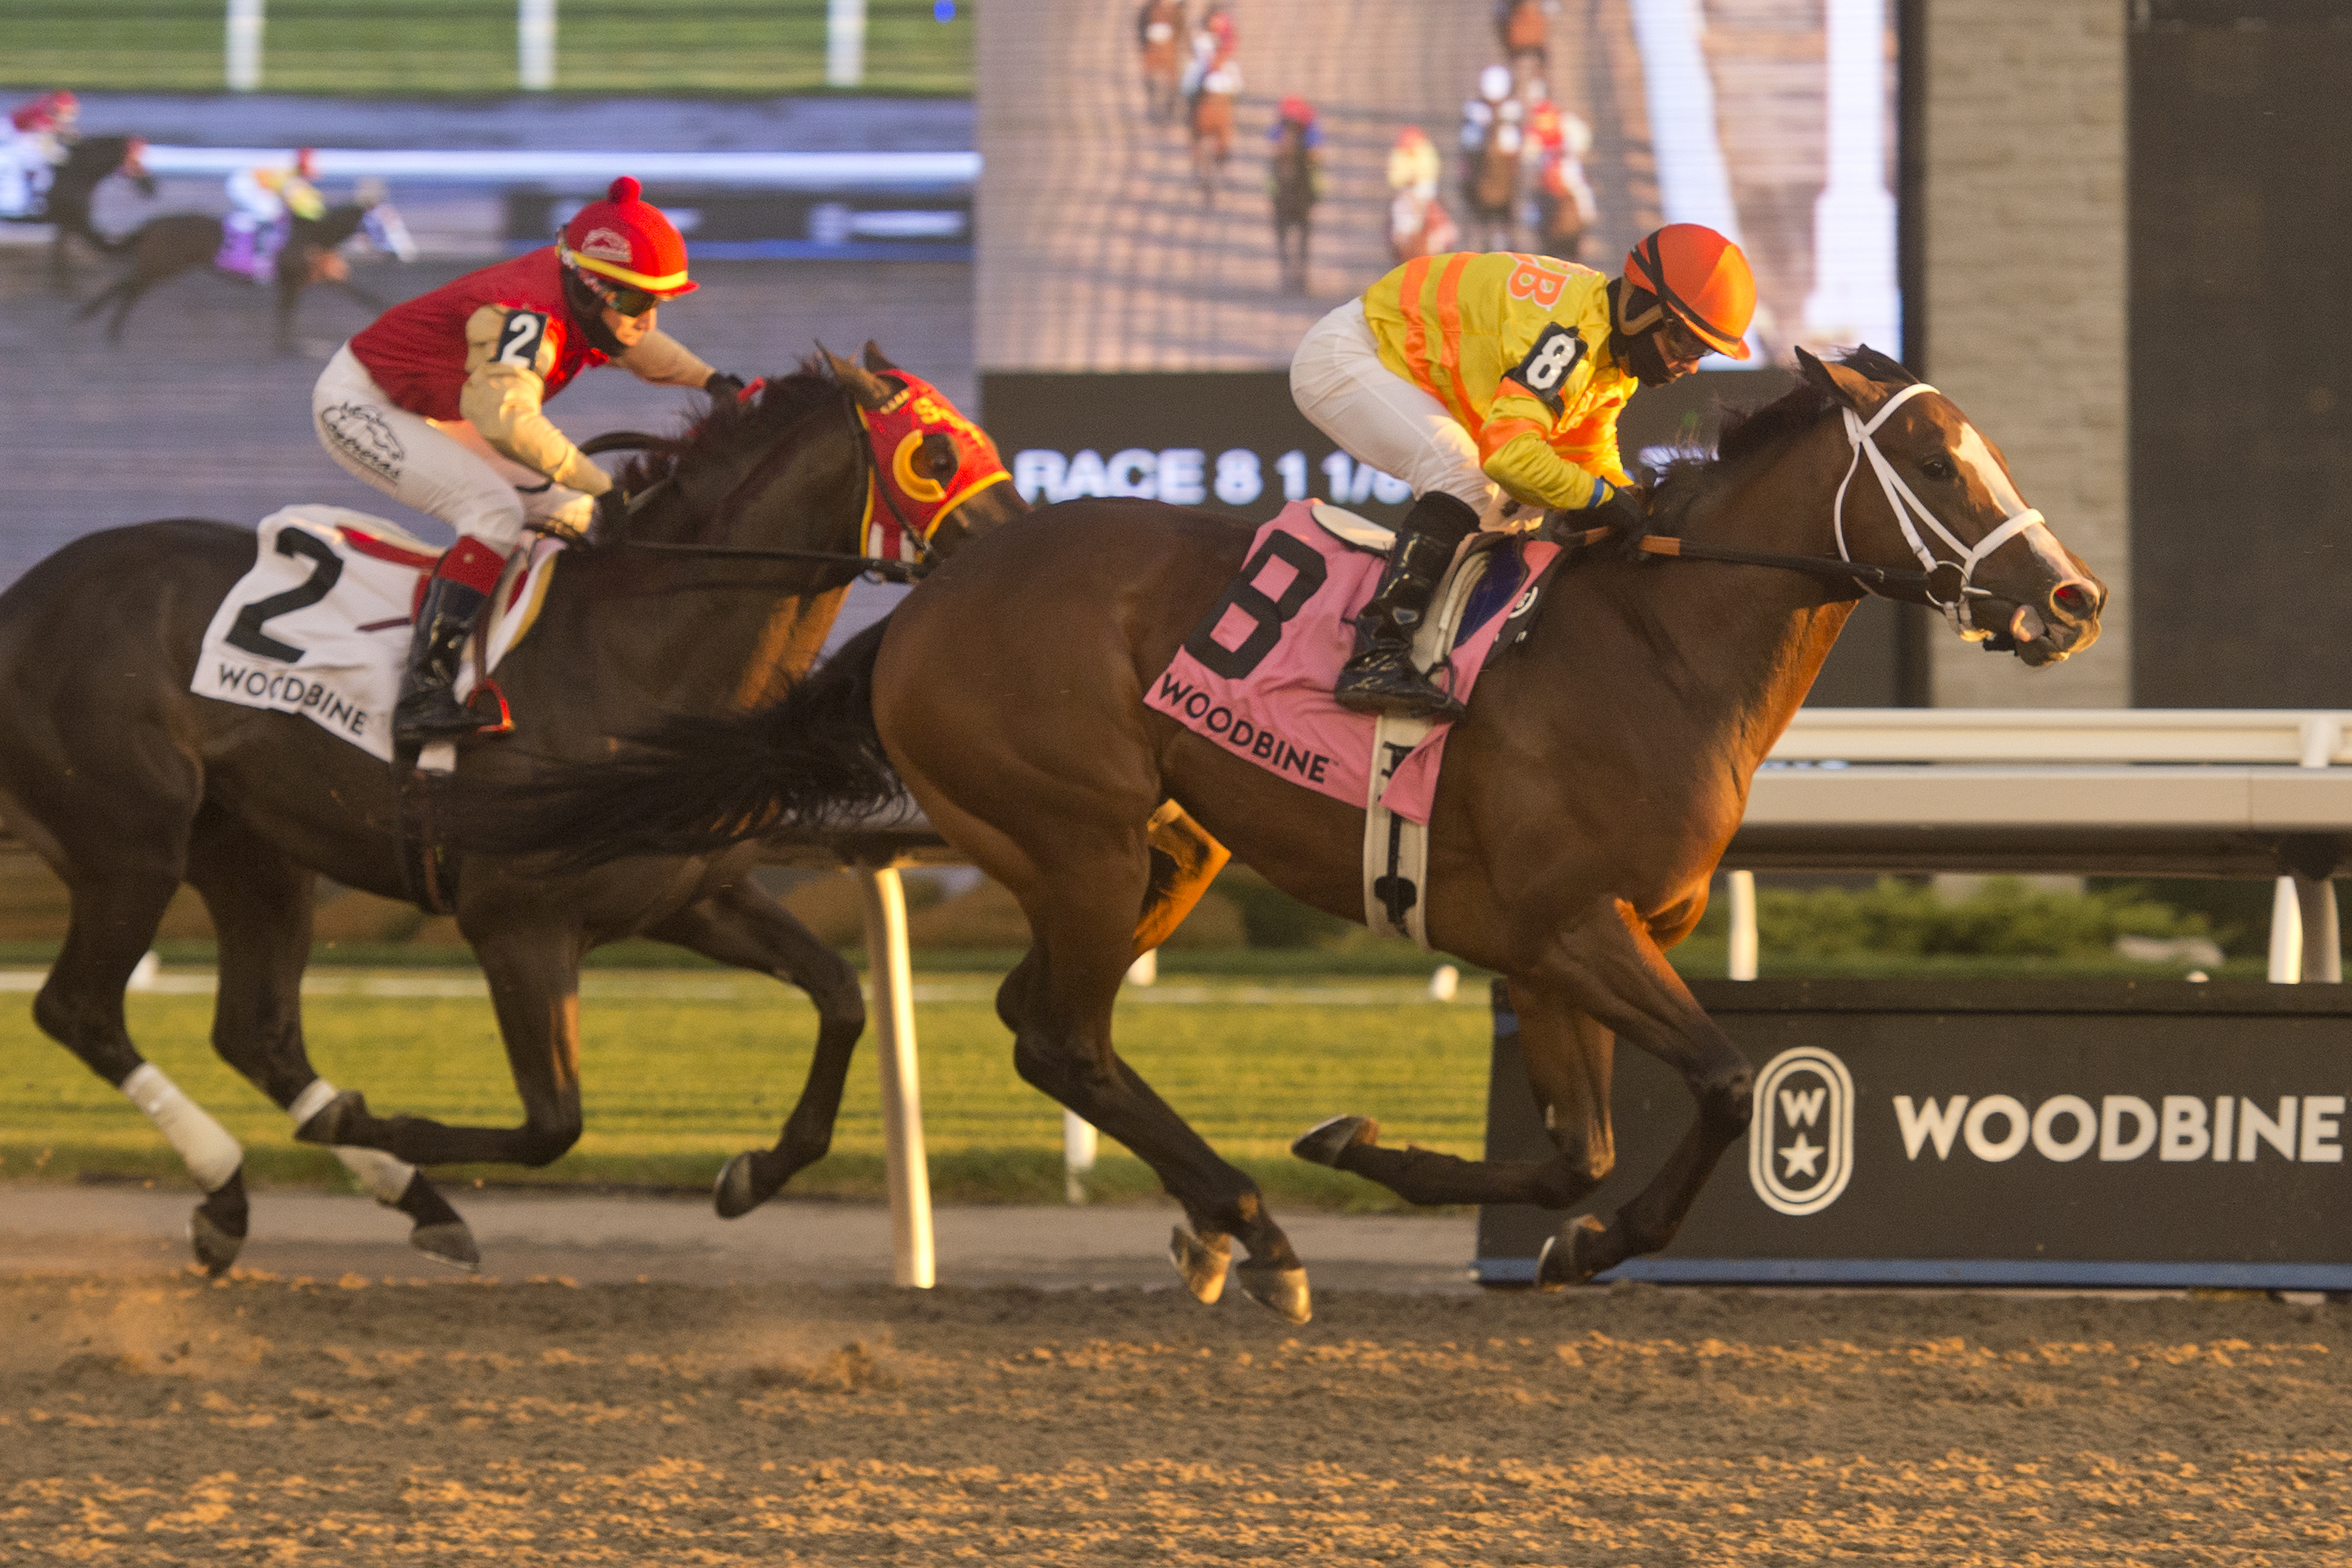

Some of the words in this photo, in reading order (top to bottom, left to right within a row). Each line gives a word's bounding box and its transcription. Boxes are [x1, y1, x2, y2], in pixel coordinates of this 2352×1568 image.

[500, 314, 540, 369] 2
[1526, 333, 1576, 391] 8
[1013, 448, 1207, 505] RACE
[1213, 448, 1264, 506] 8
[1275, 448, 1307, 503] 1
[225, 527, 344, 663] 2
[1184, 529, 1328, 679] 8
[1159, 673, 1330, 783] WOODBINE
[1778, 1087, 1827, 1128] W
[1893, 1094, 2346, 1163] WOODBINE
